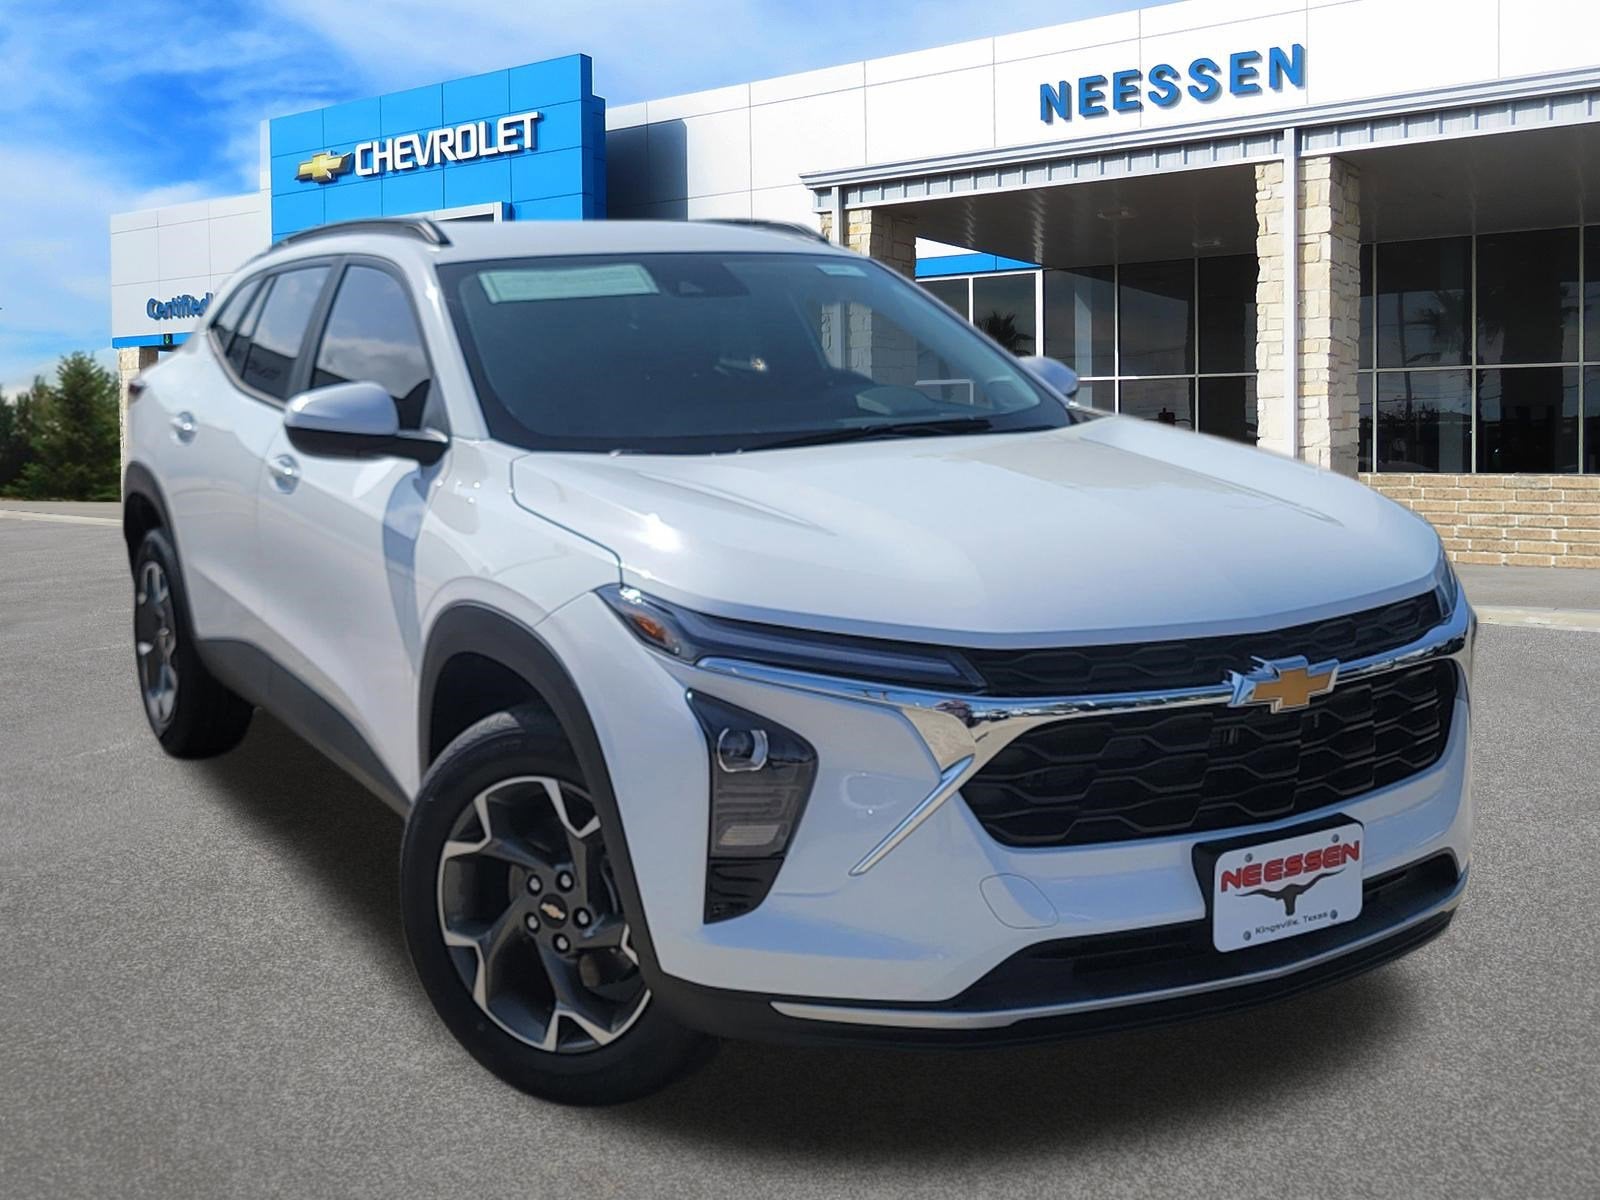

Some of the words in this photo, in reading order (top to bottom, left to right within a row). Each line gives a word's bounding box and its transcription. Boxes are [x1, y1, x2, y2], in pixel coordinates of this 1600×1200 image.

[1040, 43, 1305, 124] NEESSEN
[353, 111, 543, 177] CHEVROLET
[1220, 841, 1360, 892] NEESSEN
[1303, 911, 1328, 924] Texas
